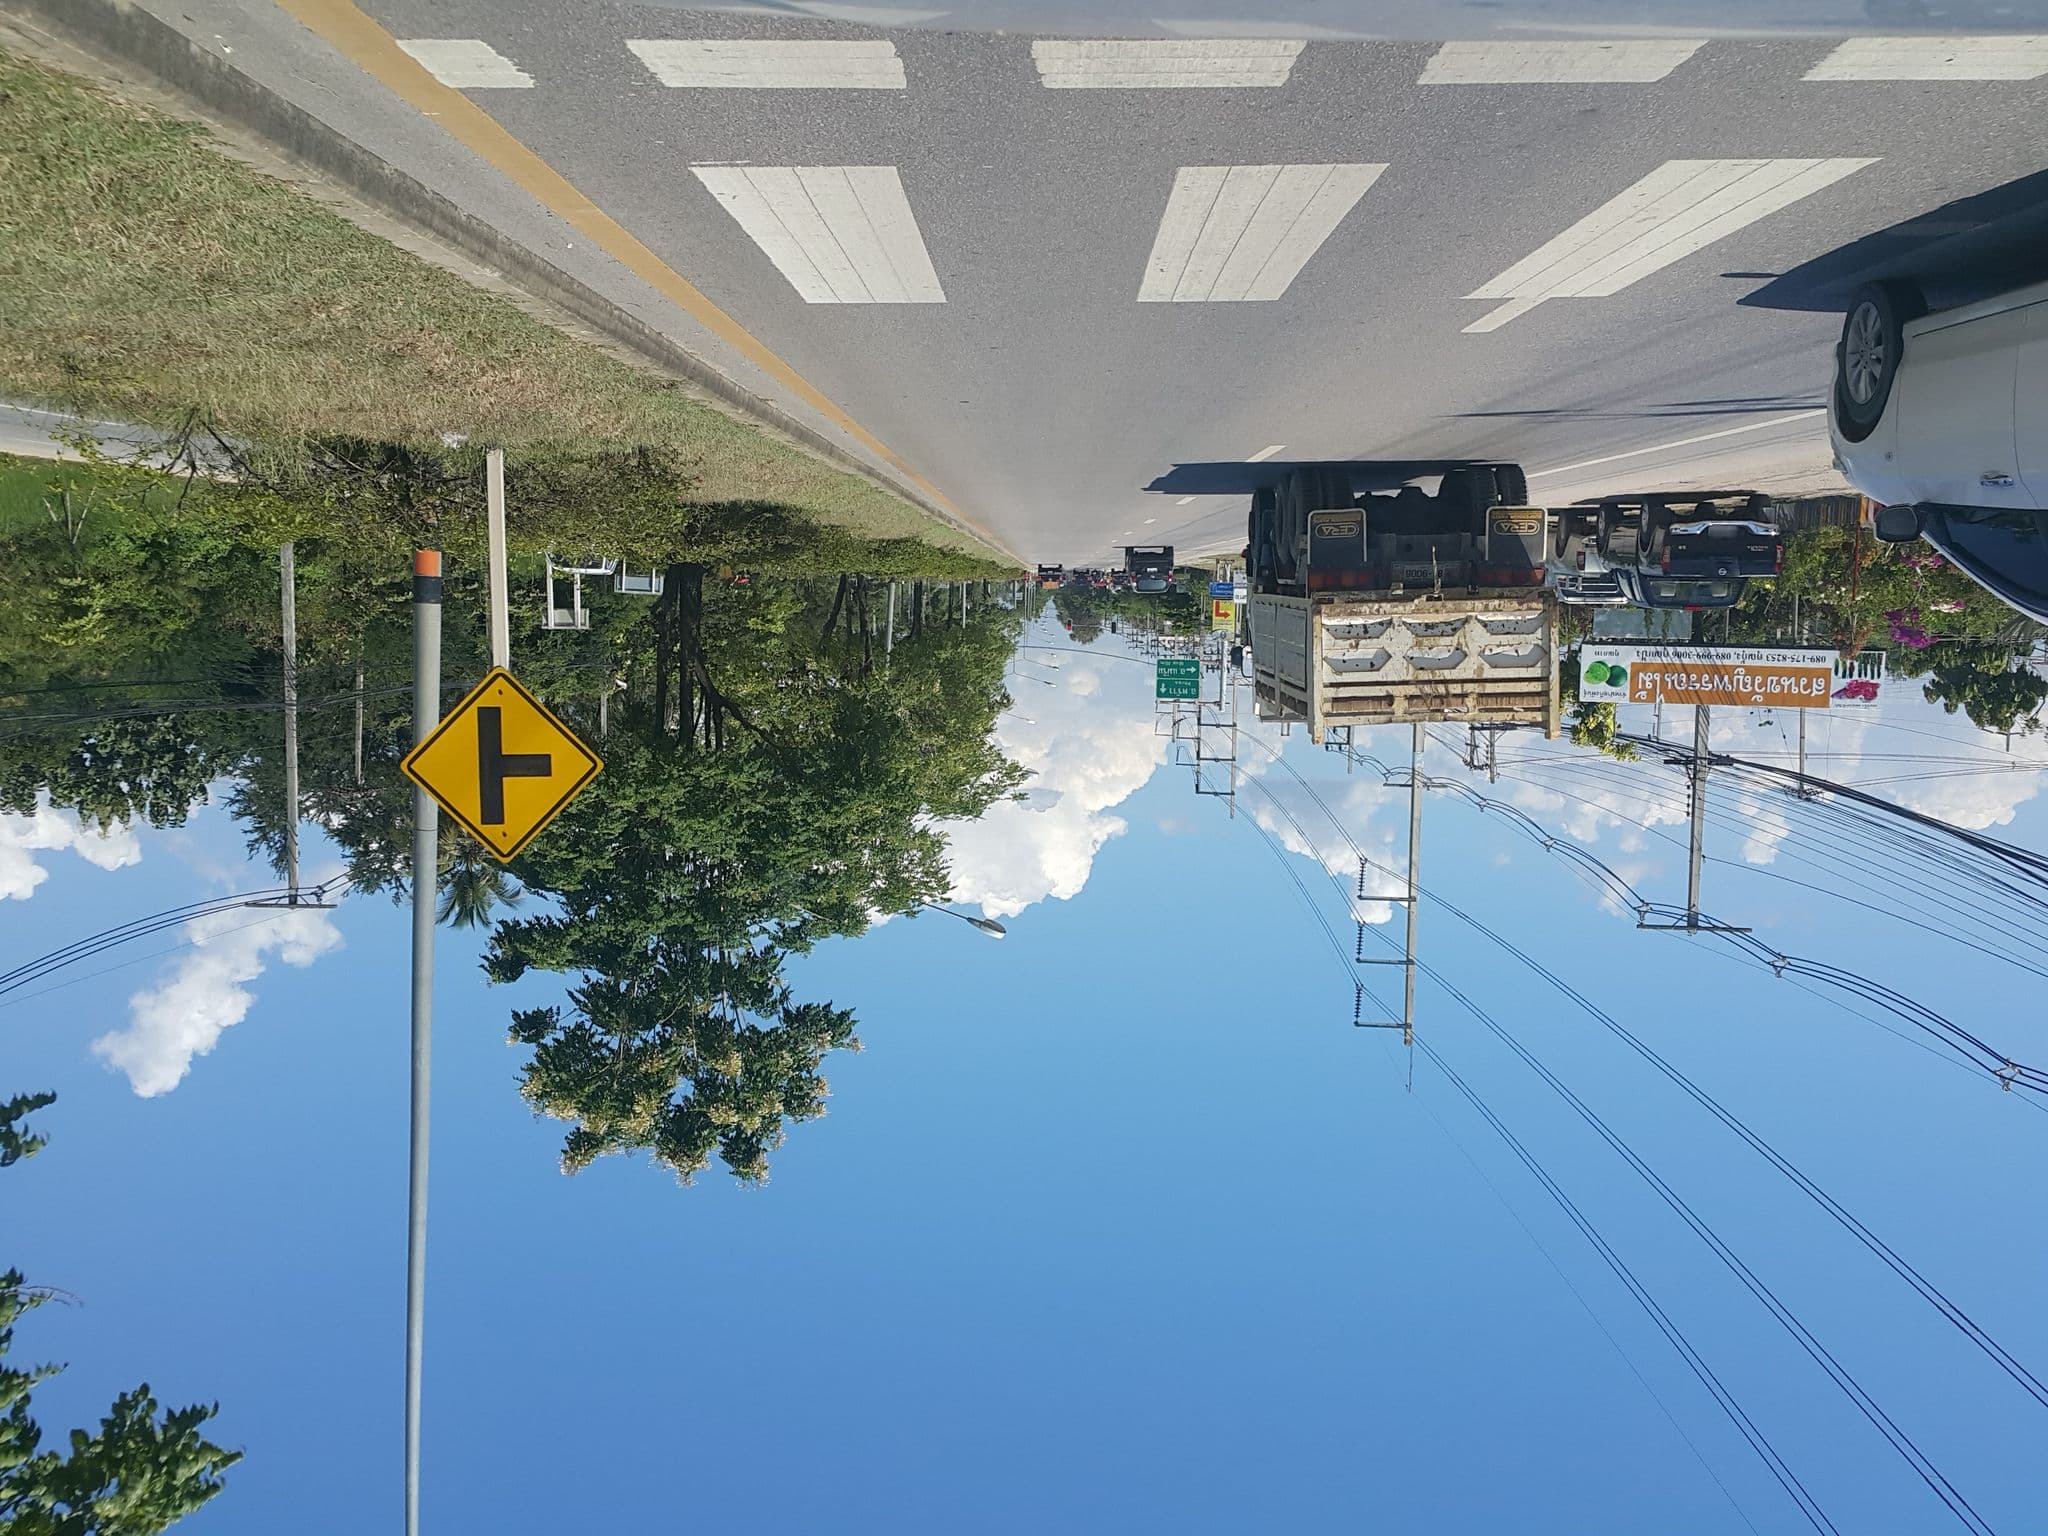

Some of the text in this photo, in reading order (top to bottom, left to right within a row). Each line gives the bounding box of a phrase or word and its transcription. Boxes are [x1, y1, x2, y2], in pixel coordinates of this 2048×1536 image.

[1321, 525, 1357, 536] CERA
[1500, 522, 1537, 533] CERA
[1766, 653, 1826, 664] 089-175-8253
[1634, 668, 1825, 705] สวนขวัญพรรณไม้
